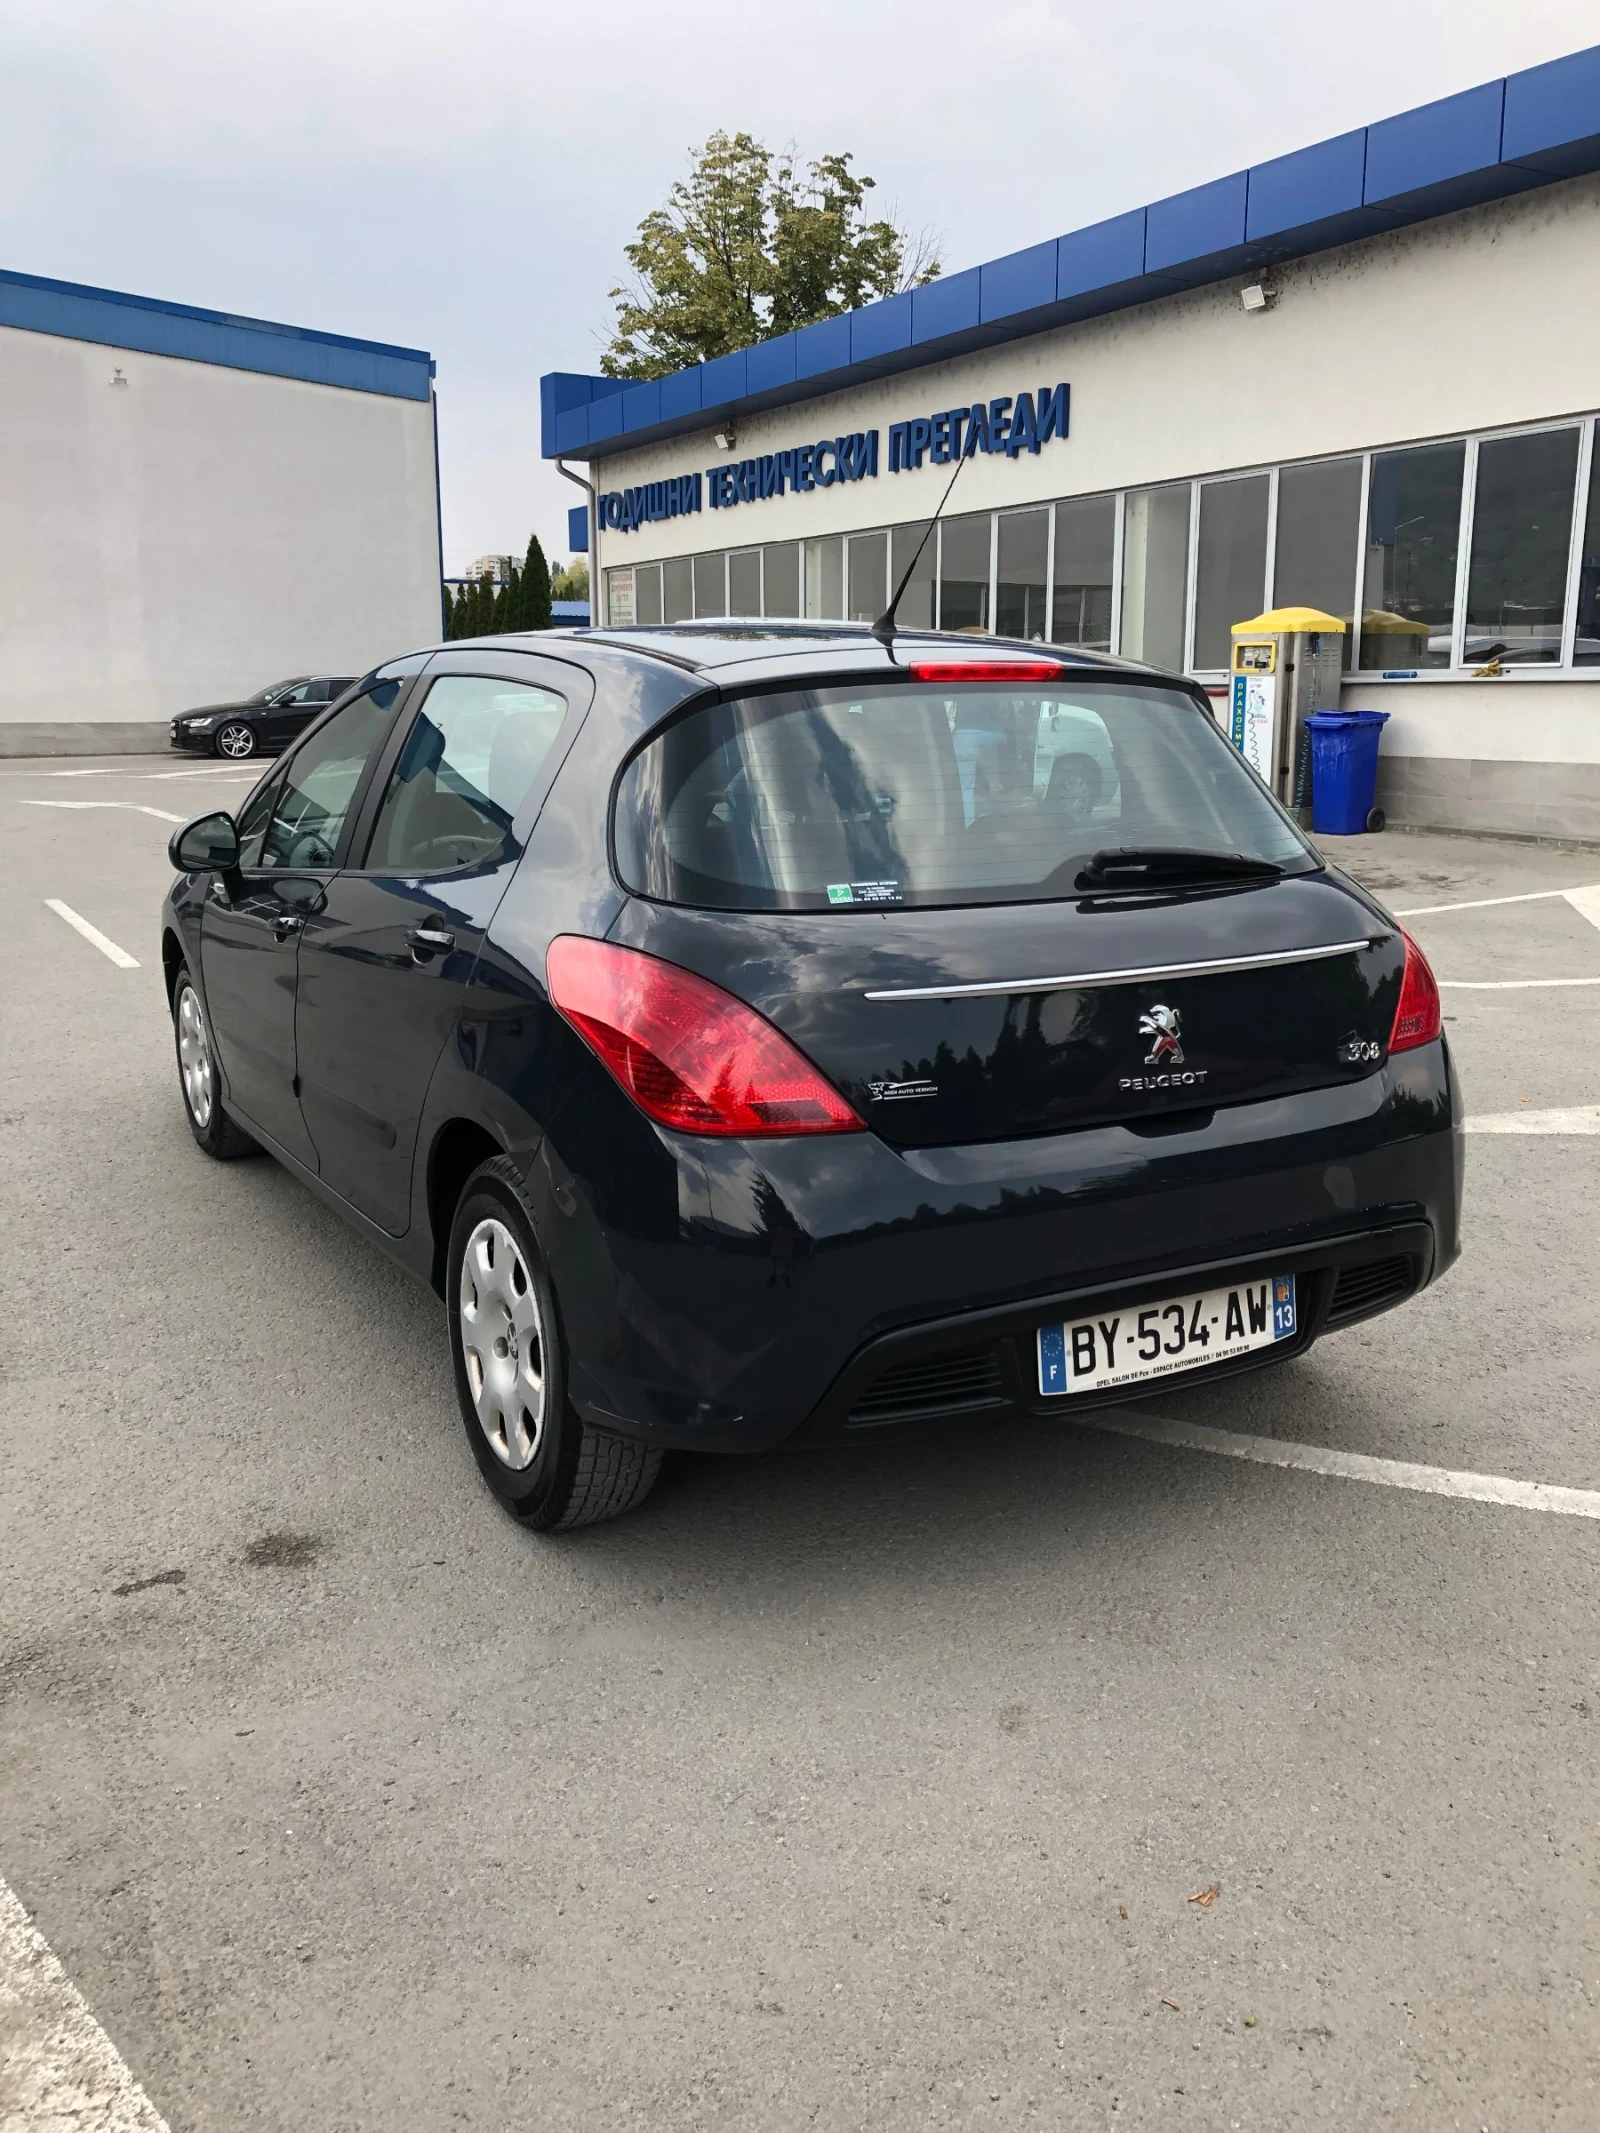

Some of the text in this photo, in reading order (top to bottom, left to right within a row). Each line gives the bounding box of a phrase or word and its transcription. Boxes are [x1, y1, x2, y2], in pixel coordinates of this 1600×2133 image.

[597, 383, 1071, 533] ГОДИШНИ ТЕХНИЧЕСКИ ПРЕГЛЕДИ
[1348, 1041, 1381, 1061] 308
[1119, 1071, 1208, 1091] PEUGEOT
[1275, 1304, 1293, 1329] 13
[1071, 1284, 1267, 1377] BY-534-AW
[1050, 1364, 1058, 1380] F
[1096, 1379, 1111, 1388] OPEL
[1111, 1374, 1130, 1384] SALON
[1131, 1371, 1138, 1380] DE
[1139, 1370, 1149, 1378] Pce
[1153, 1363, 1173, 1374] ESPACE
[1174, 1355, 1210, 1369] AUTOMOBILES
